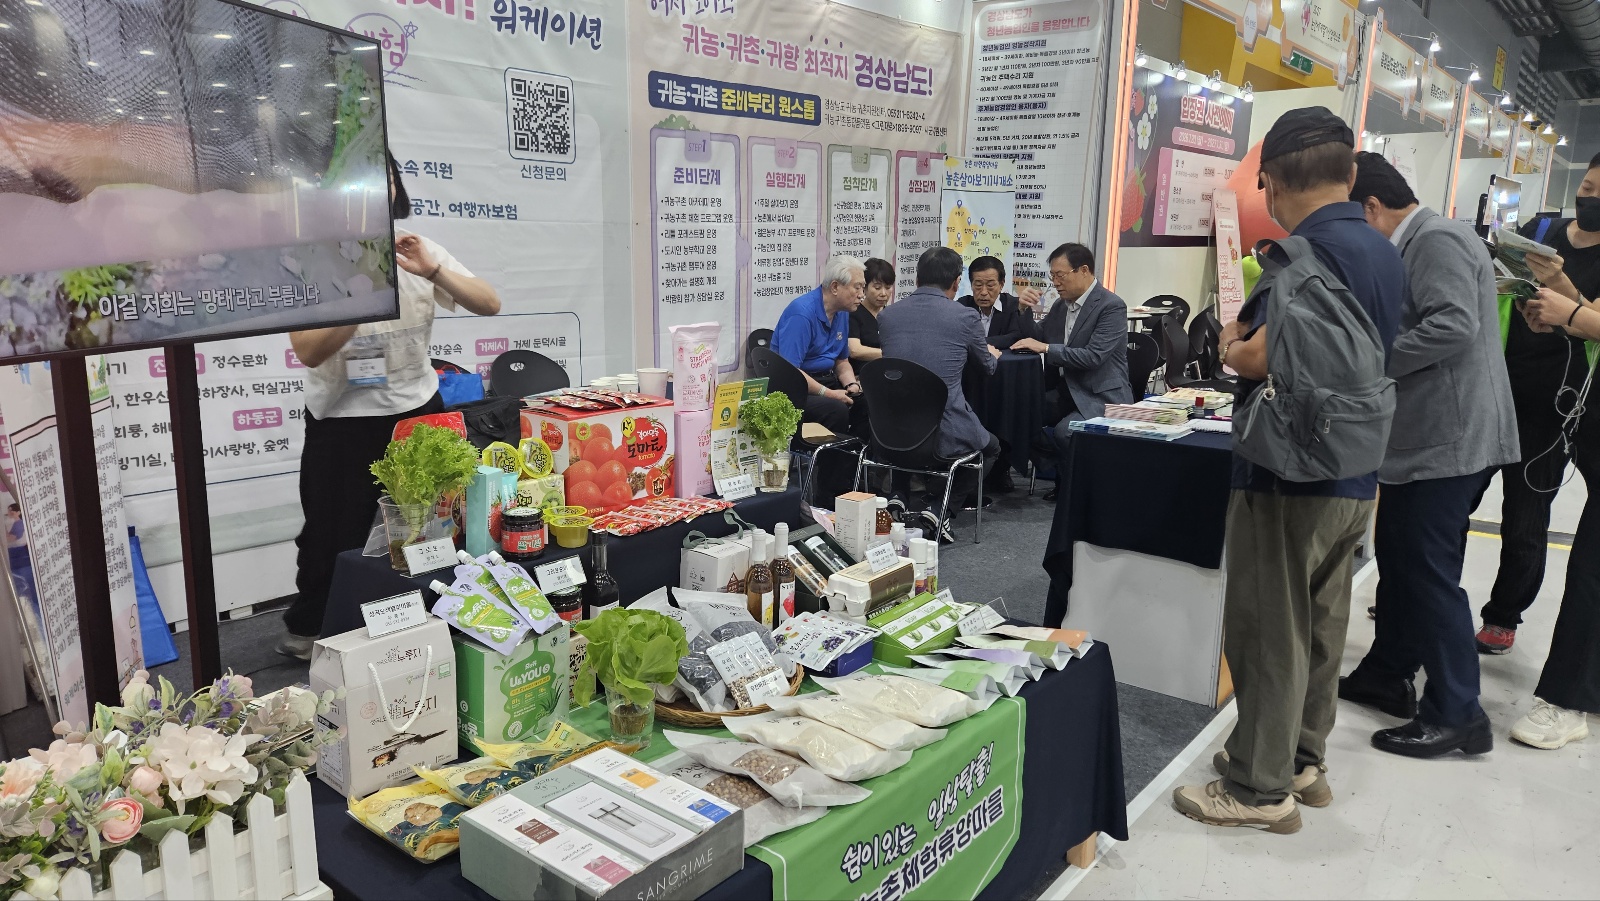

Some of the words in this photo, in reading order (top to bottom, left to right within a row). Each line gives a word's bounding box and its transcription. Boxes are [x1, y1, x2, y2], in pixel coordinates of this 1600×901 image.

[490, 0, 602, 50] 워케이션
[1042, 16, 1090, 31] 응원합니다
[804, 46, 849, 81] 최적지
[854, 53, 934, 96] 경상남도!
[657, 79, 718, 108] 귀농·귀촌
[721, 88, 775, 115] 준비부터
[778, 95, 816, 121] 원스톱
[1182, 96, 1205, 122] 입장권
[423, 161, 453, 179] 직원
[520, 165, 567, 181] 신청문의
[673, 167, 721, 185] 준비단계
[765, 171, 806, 189] 실행단계
[843, 176, 877, 191] 정착단계
[908, 179, 936, 193] 성장단계
[945, 171, 1013, 187] 농촌살아보기14개소
[710, 198, 722, 207] 운영
[448, 202, 518, 220] 여행자보험
[706, 229, 717, 238] 운영
[706, 245, 717, 255] 운영
[706, 260, 717, 270] 운영
[665, 278, 687, 288] 찾아가는
[100, 294, 138, 321] 이걸
[142, 292, 196, 317] 저희는
[197, 287, 264, 313] '망태'라고
[267, 282, 321, 306] 부릅니다
[665, 294, 682, 304] 박람회
[714, 291, 725, 301] 운영
[477, 341, 506, 352] 거제시
[514, 338, 531, 349] 거제
[533, 336, 567, 347] 둔덕시골
[212, 354, 268, 368] 정수문화
[198, 385, 249, 399] 하장사,
[252, 380, 304, 395] 덕실감빛
[236, 411, 278, 425] 하동군
[905, 615, 917, 624] SOAP
[841, 834, 878, 882] 쉼이
[881, 822, 917, 865] 있는
[928, 741, 995, 829] 일상탈출!
[637, 847, 713, 901] SANGRIME
